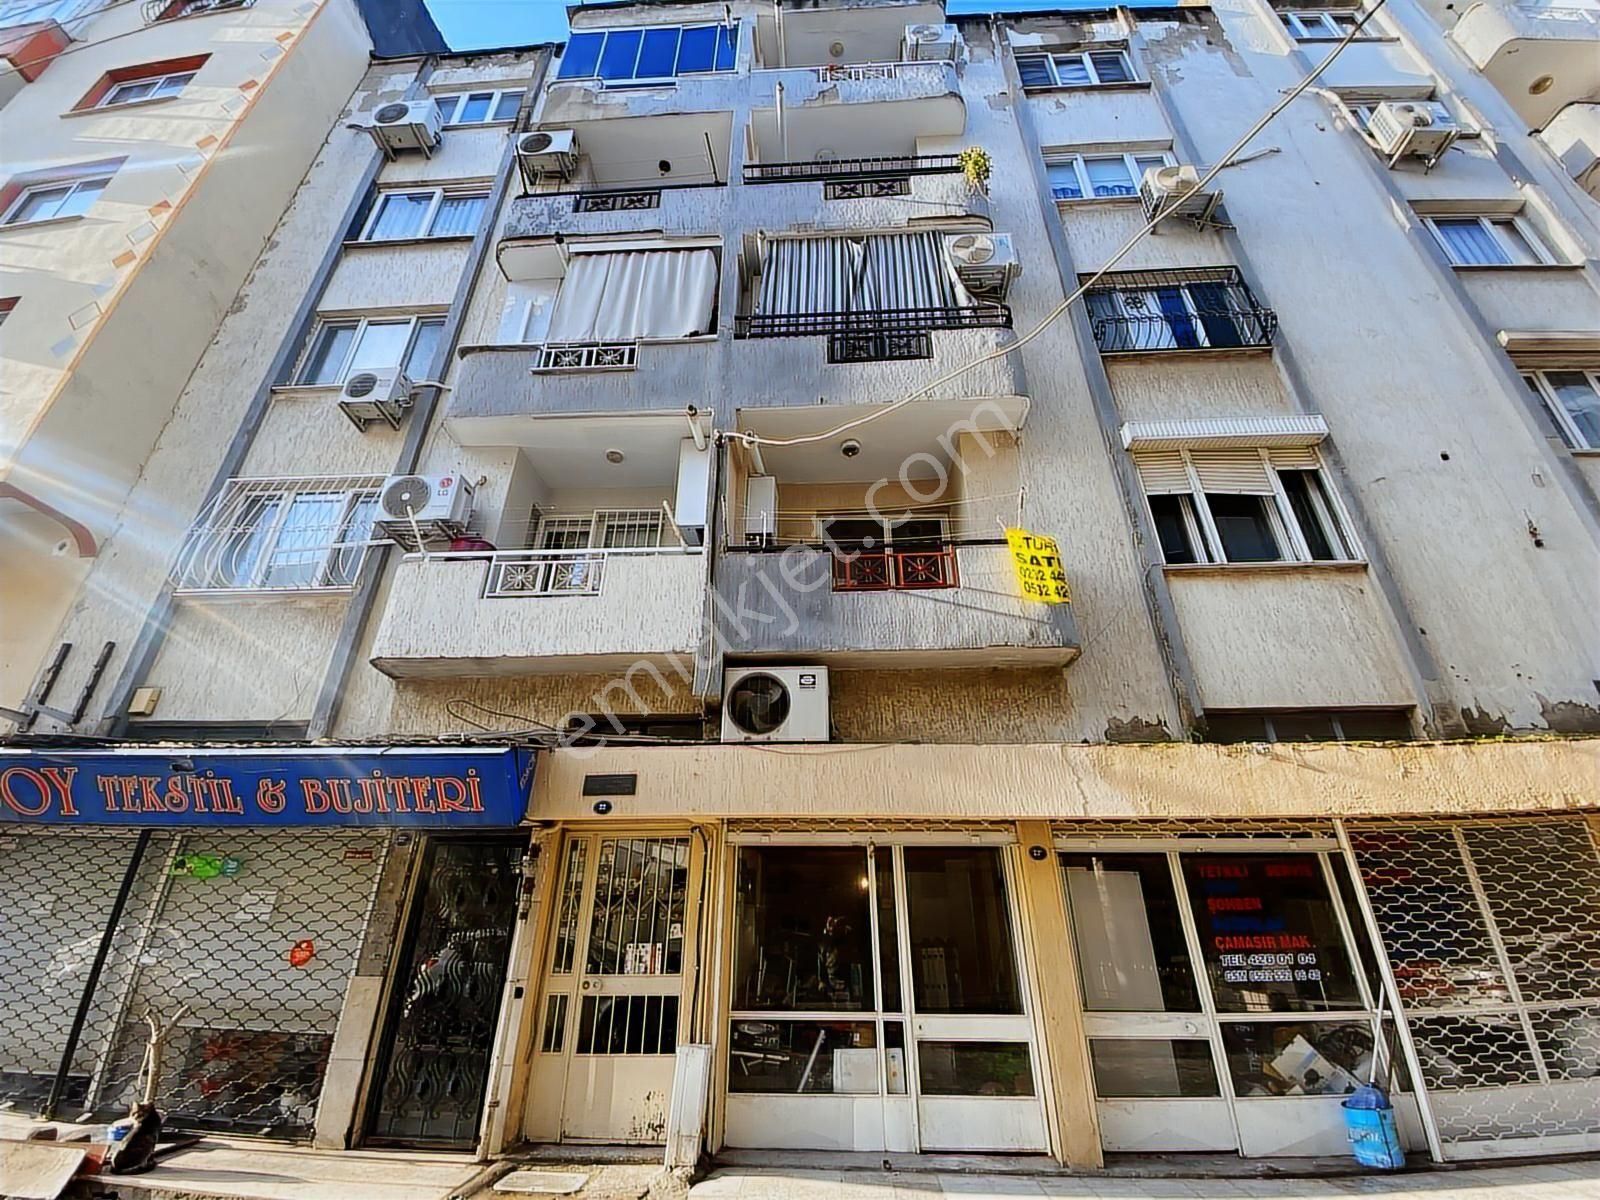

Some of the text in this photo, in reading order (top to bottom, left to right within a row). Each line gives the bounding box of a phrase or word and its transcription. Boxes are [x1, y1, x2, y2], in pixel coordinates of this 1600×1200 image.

[97, 770, 244, 815] TEKSTİL
[256, 778, 287, 813] &
[300, 768, 487, 815] BUJİTERİ
[1220, 953, 1246, 967] TEL
